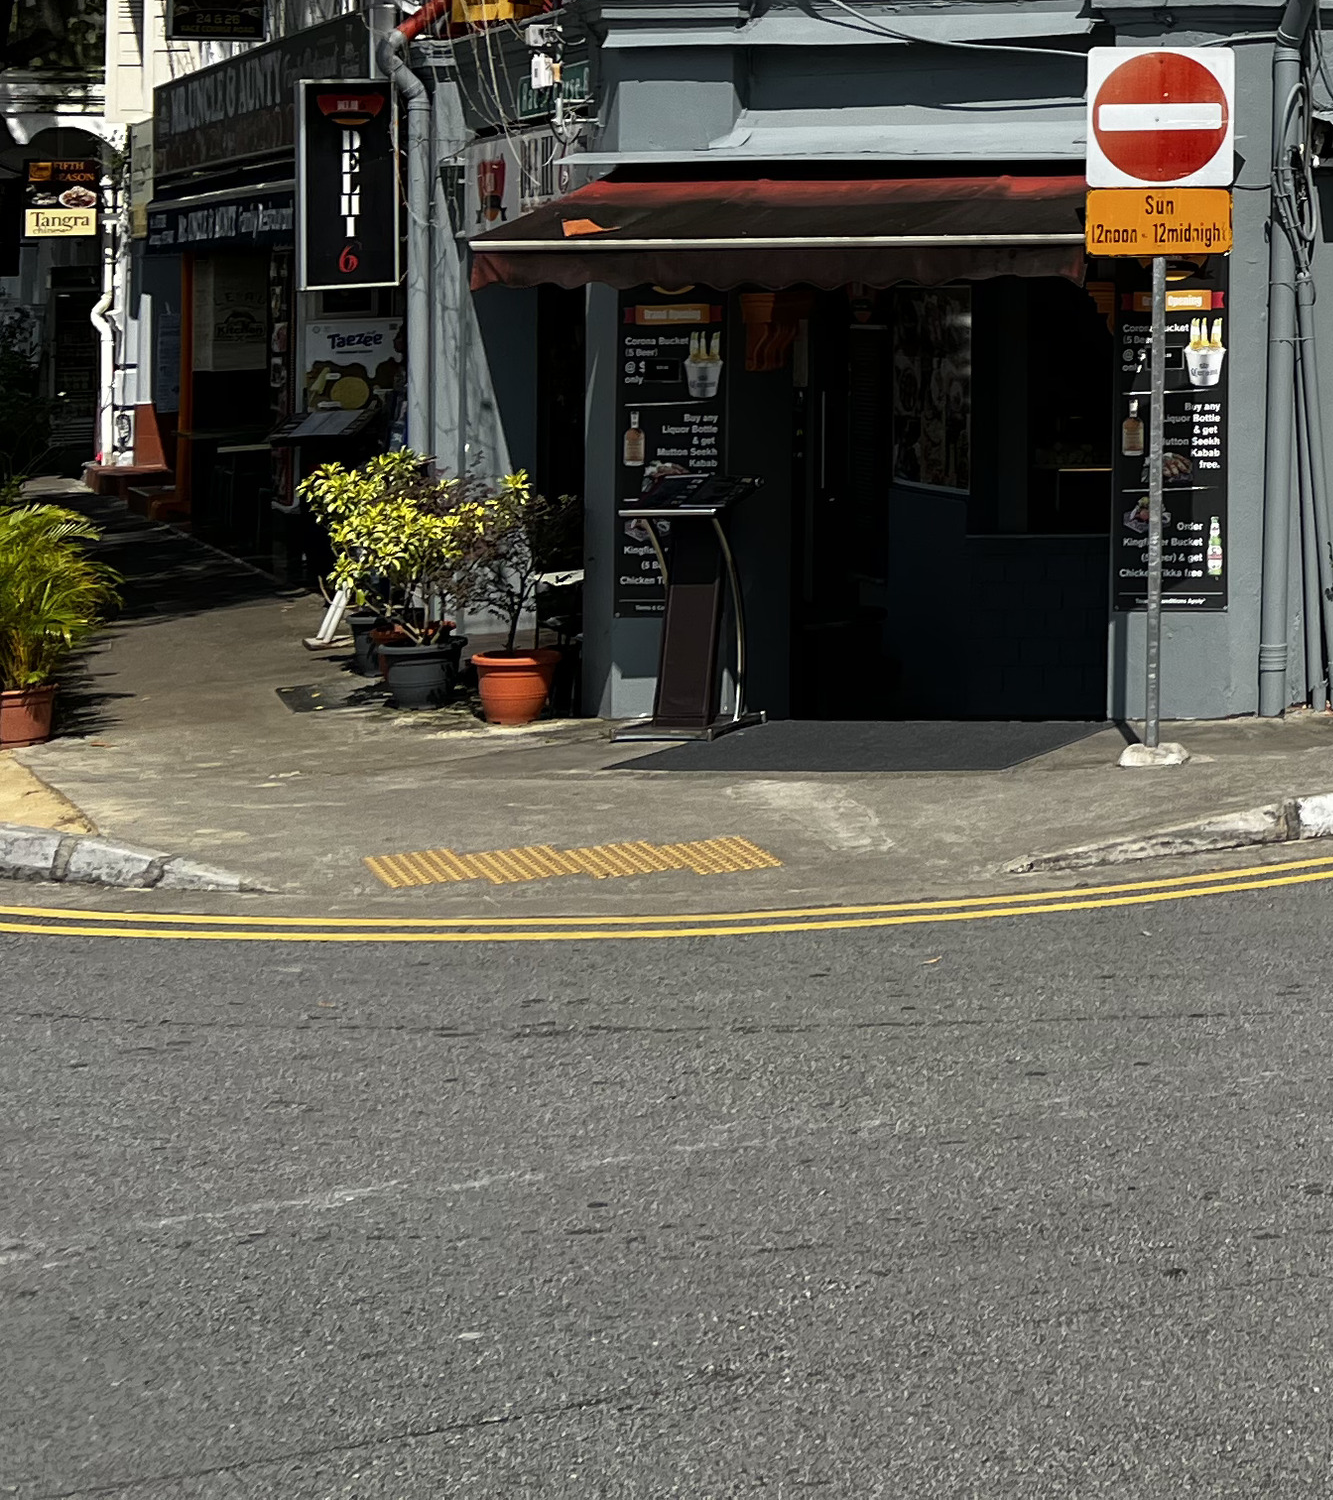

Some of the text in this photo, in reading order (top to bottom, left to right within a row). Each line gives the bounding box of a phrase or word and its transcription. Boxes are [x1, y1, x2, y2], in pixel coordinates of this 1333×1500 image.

[340, 129, 362, 238] DELHI
[1144, 194, 1175, 215] Sun
[30, 211, 90, 230] Tangra
[1091, 223, 1138, 244] 12noon
[337, 242, 362, 274] 6
[1164, 322, 1190, 333] ucket
[327, 331, 383, 350] Taezee
[624, 336, 689, 346] Corona Bucket
[1122, 348, 1134, 362] @
[624, 360, 636, 374] @
[1184, 402, 1221, 413] Buy any
[683, 413, 701, 424] Buy
[1164, 413, 1221, 425] iquor Bottle
[661, 424, 719, 435] Liquor Bottle
[1192, 424, 1218, 436] & get
[1191, 436, 1221, 446] Seekh
[656, 447, 689, 457] Mutton
[1190, 448, 1221, 458] Kabab
[1198, 459, 1221, 469] free.
[1176, 521, 1204, 531] Order
[1170, 536, 1204, 547] Bucket
[1187, 552, 1204, 563] get
[1118, 568, 1150, 578] Chicke
[1184, 568, 1204, 578] free
[619, 575, 656, 586] Chicken
